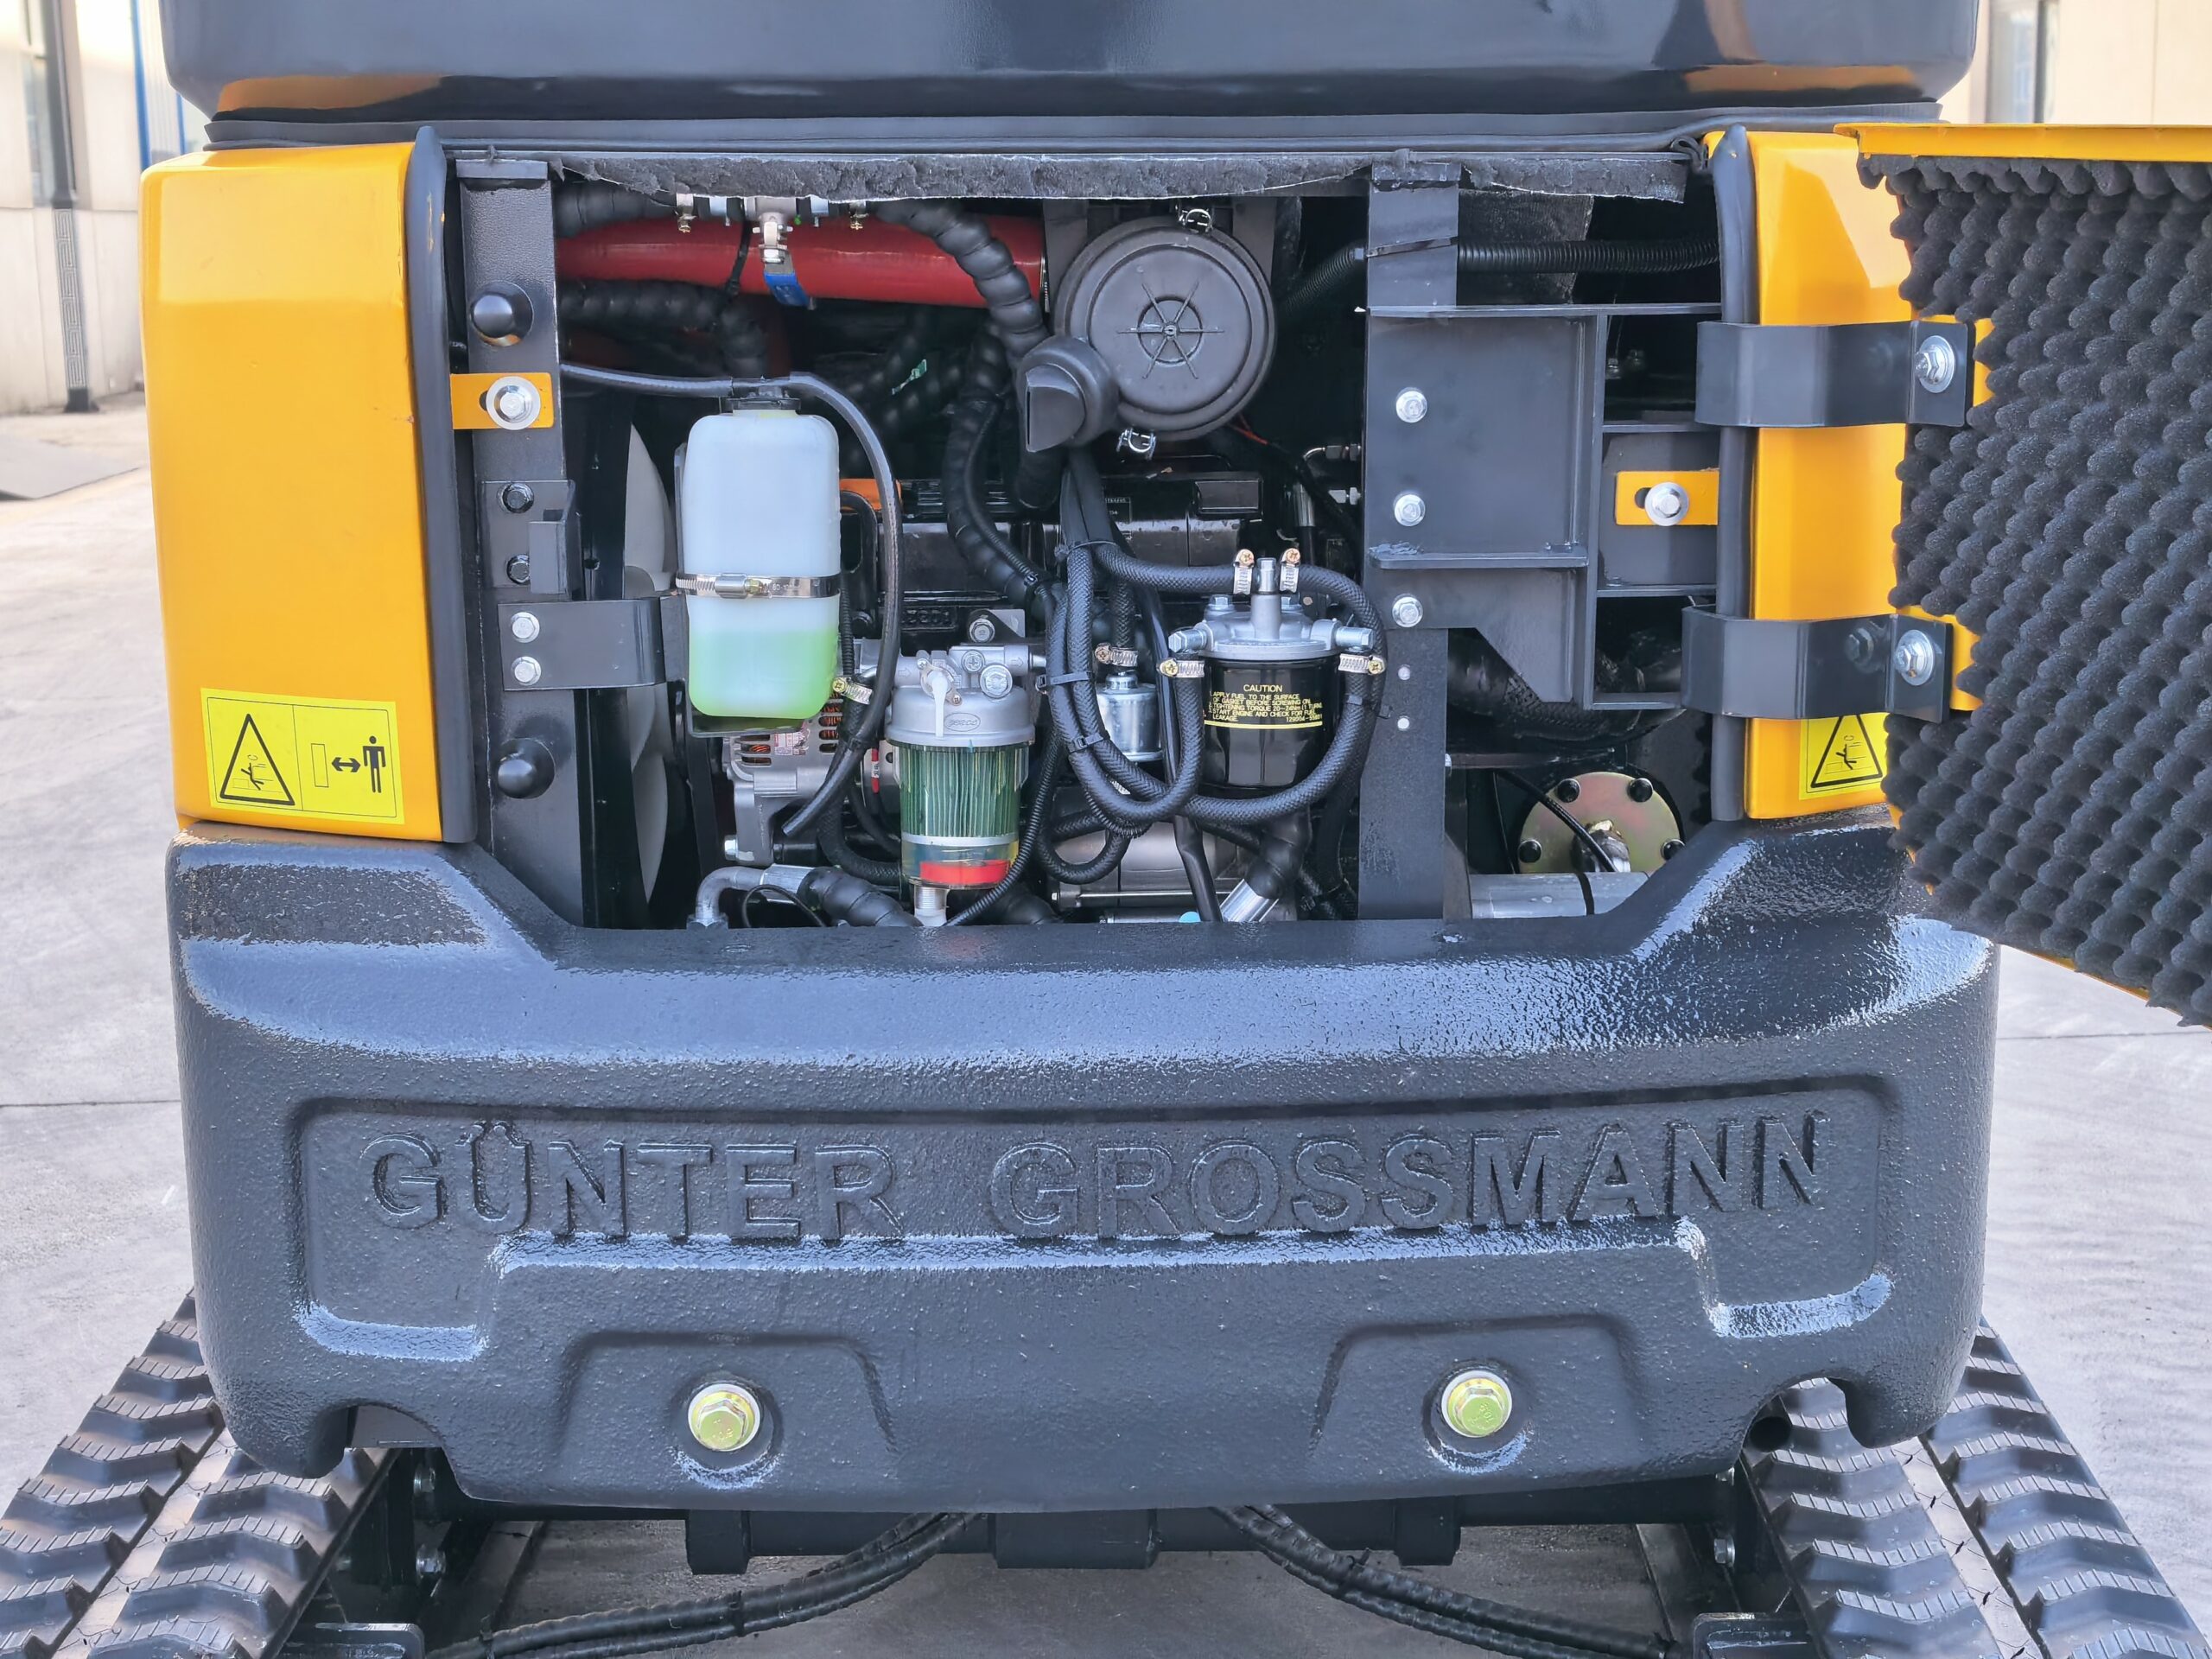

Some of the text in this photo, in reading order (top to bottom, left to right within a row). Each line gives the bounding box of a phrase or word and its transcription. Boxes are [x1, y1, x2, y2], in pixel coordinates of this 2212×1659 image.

[1243, 684, 1283, 693] CAUTION
[359, 1109, 1830, 1241] GÜNTER GROSSMANN
